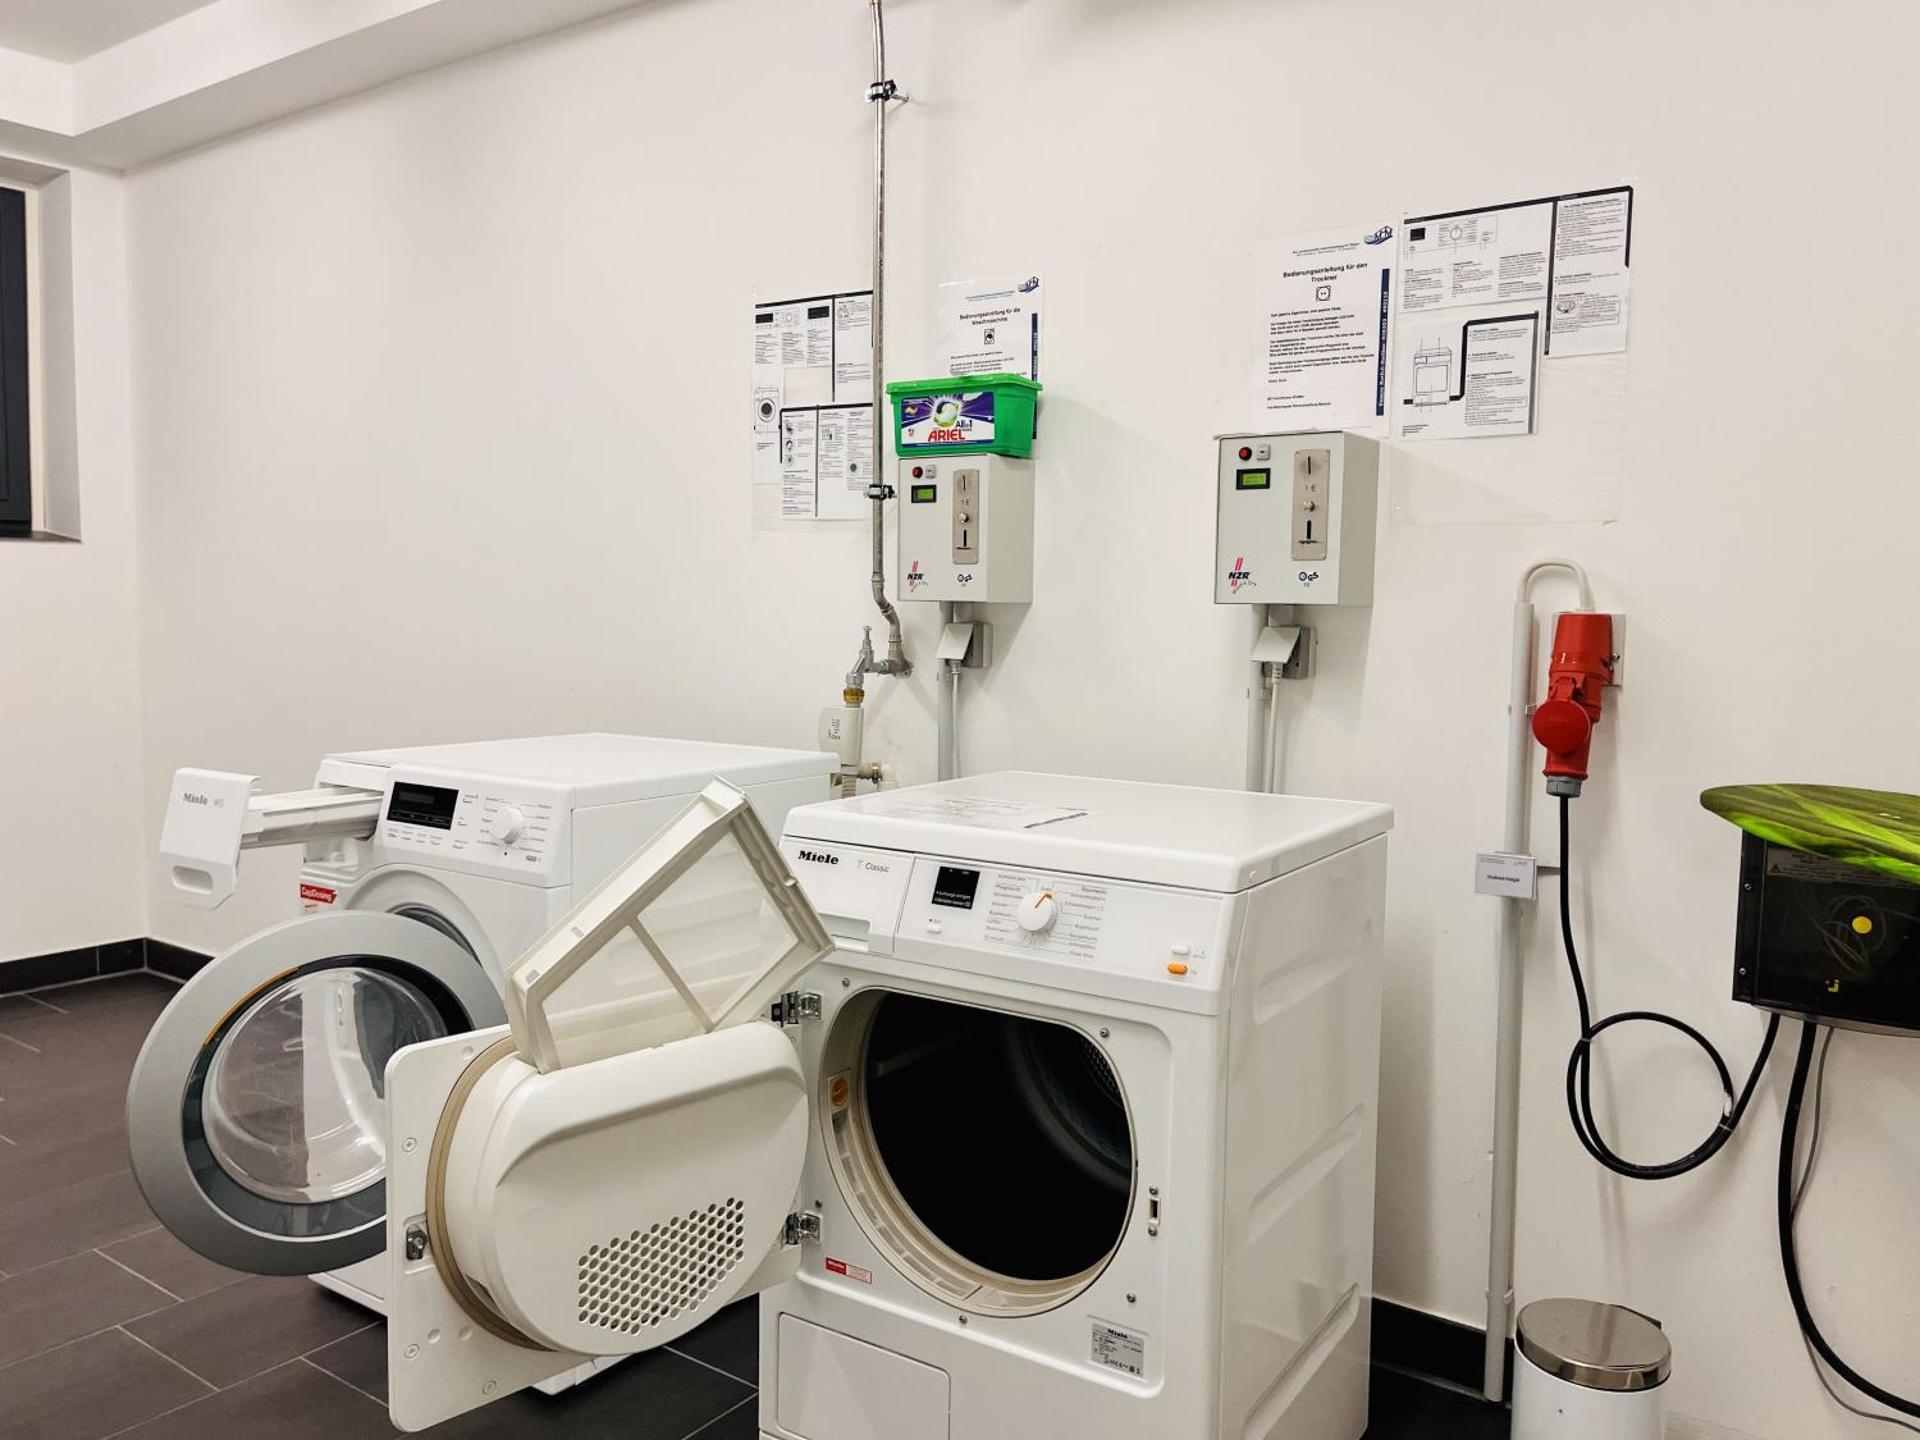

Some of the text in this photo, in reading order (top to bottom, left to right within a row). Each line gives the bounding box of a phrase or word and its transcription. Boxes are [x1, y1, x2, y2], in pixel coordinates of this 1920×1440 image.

[1283, 262, 1368, 278] Bedienungsanleitung für den
[928, 429, 965, 442] ARIEL
[183, 792, 209, 806] Miele
[798, 850, 840, 866] Miele
[865, 861, 891, 874] Classic
[1107, 1329, 1127, 1339] Miele
